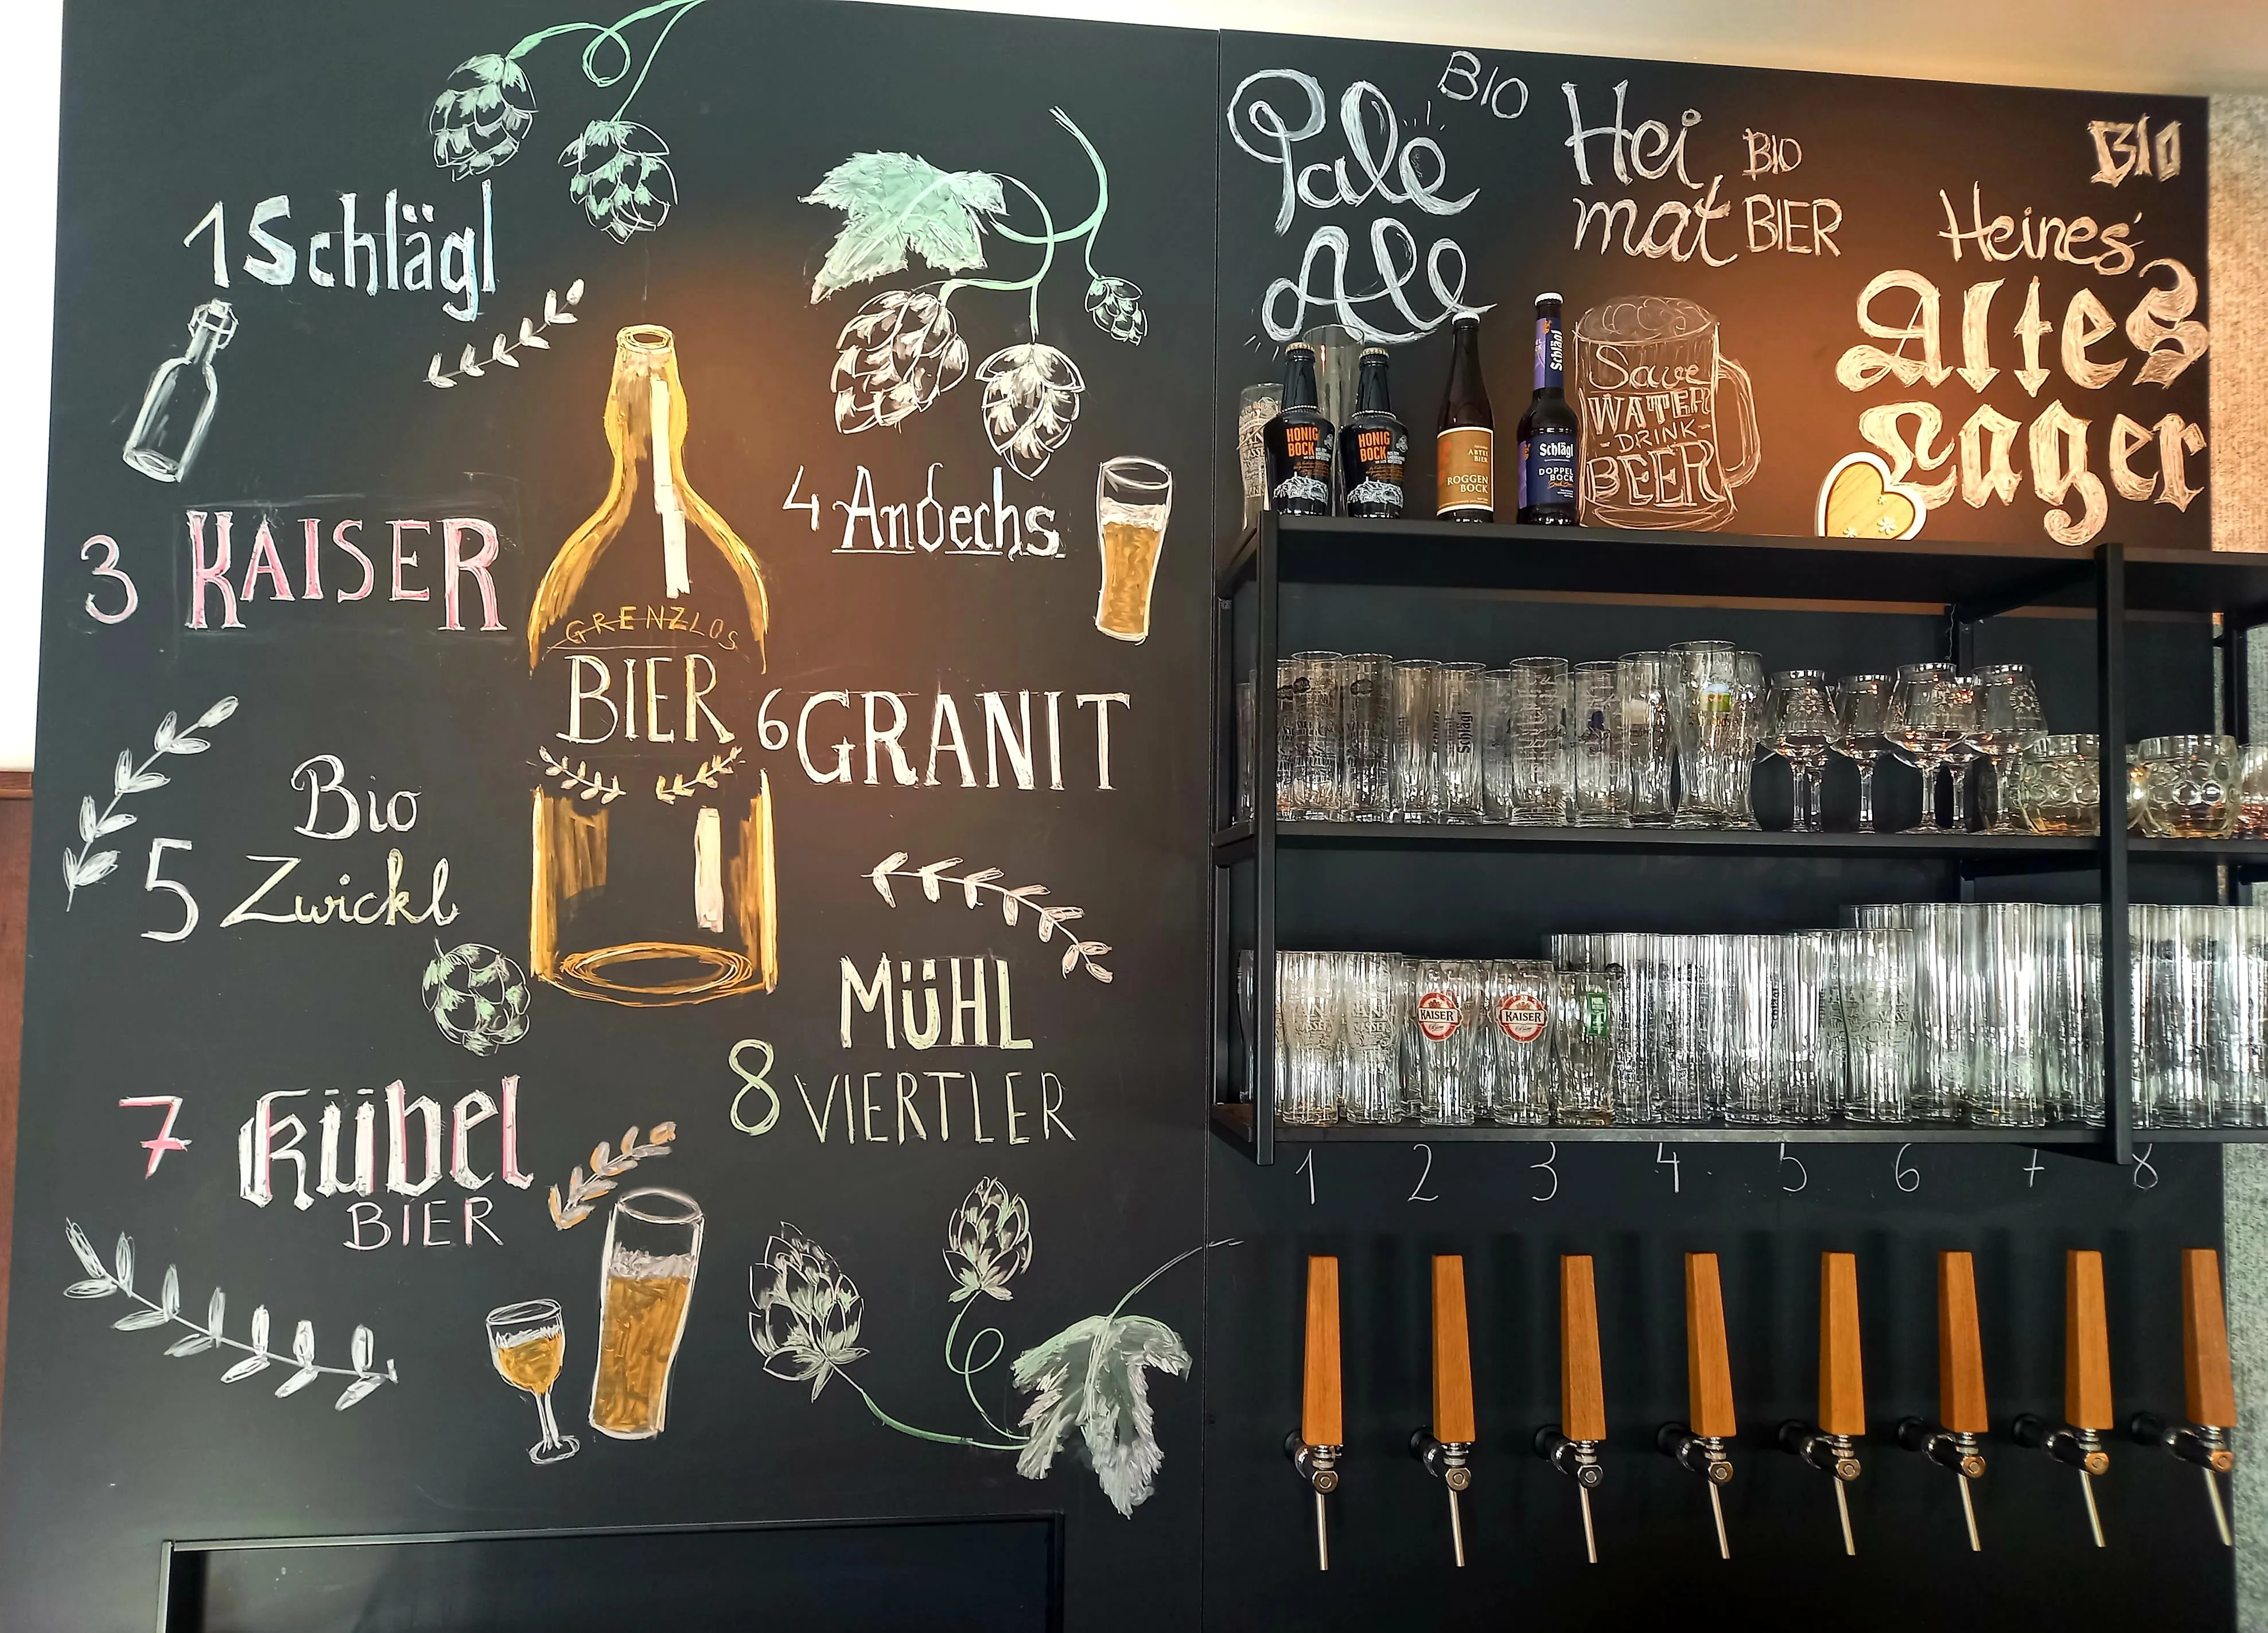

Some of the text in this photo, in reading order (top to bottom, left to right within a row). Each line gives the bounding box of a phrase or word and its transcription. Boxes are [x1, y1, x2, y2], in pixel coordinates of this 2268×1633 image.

[1437, 50, 1530, 119] BIO
[1227, 68, 1480, 236] Pale
[1561, 79, 1705, 189] Hei
[1742, 127, 1802, 179] BIO
[2088, 114, 2181, 186] BIO
[1573, 174, 1739, 268] mat
[1742, 195, 1843, 258] BIER
[183, 179, 497, 322] 1 Schlägl
[1261, 217, 1497, 344] Ale
[1835, 258, 2209, 398] Altes
[1589, 344, 1712, 390] Save
[1286, 427, 1318, 443] HONIG
[1588, 387, 1712, 435] WATER
[1287, 442, 1315, 457] BOCK
[1358, 431, 1391, 448] HONIG
[1360, 446, 1387, 462] BOCK
[1468, 449, 1488, 457] ABTEI
[1539, 442, 1573, 458] Schlägl
[1447, 475, 1488, 486] ROGGEN
[1460, 484, 1488, 493] BOCK
[1538, 467, 1574, 476] DOPPEL
[1550, 475, 1574, 483] BOCK
[1586, 441, 1729, 507] BEER
[1858, 398, 2207, 547] Lager
[783, 462, 1066, 562] 4 Andechs
[80, 510, 508, 632] 3 KAISER
[565, 604, 738, 651] GRENZLOS
[556, 654, 736, 744] BIER
[757, 688, 1131, 792] 6 GRANIT
[1457, 711, 1473, 753] Schlägl
[290, 754, 421, 839] Bio
[140, 837, 460, 942] 5 Zwickl
[1420, 1009, 1454, 1021] KAISER
[1505, 1011, 1542, 1022] KAISER
[728, 1039, 1076, 1145] 8 VIERTLER
[118, 1075, 534, 1211] 7 Kübel
[1656, 1142, 1680, 1193] 4
[1780, 1143, 1807, 1192] 5
[1895, 1143, 1920, 1192] 6
[2132, 1143, 2159, 1190] 8
[1295, 1148, 1315, 1204] 1
[1407, 1144, 1439, 1202] 2
[1530, 1142, 1558, 1202] 3
[343, 1196, 504, 1251] BIER
